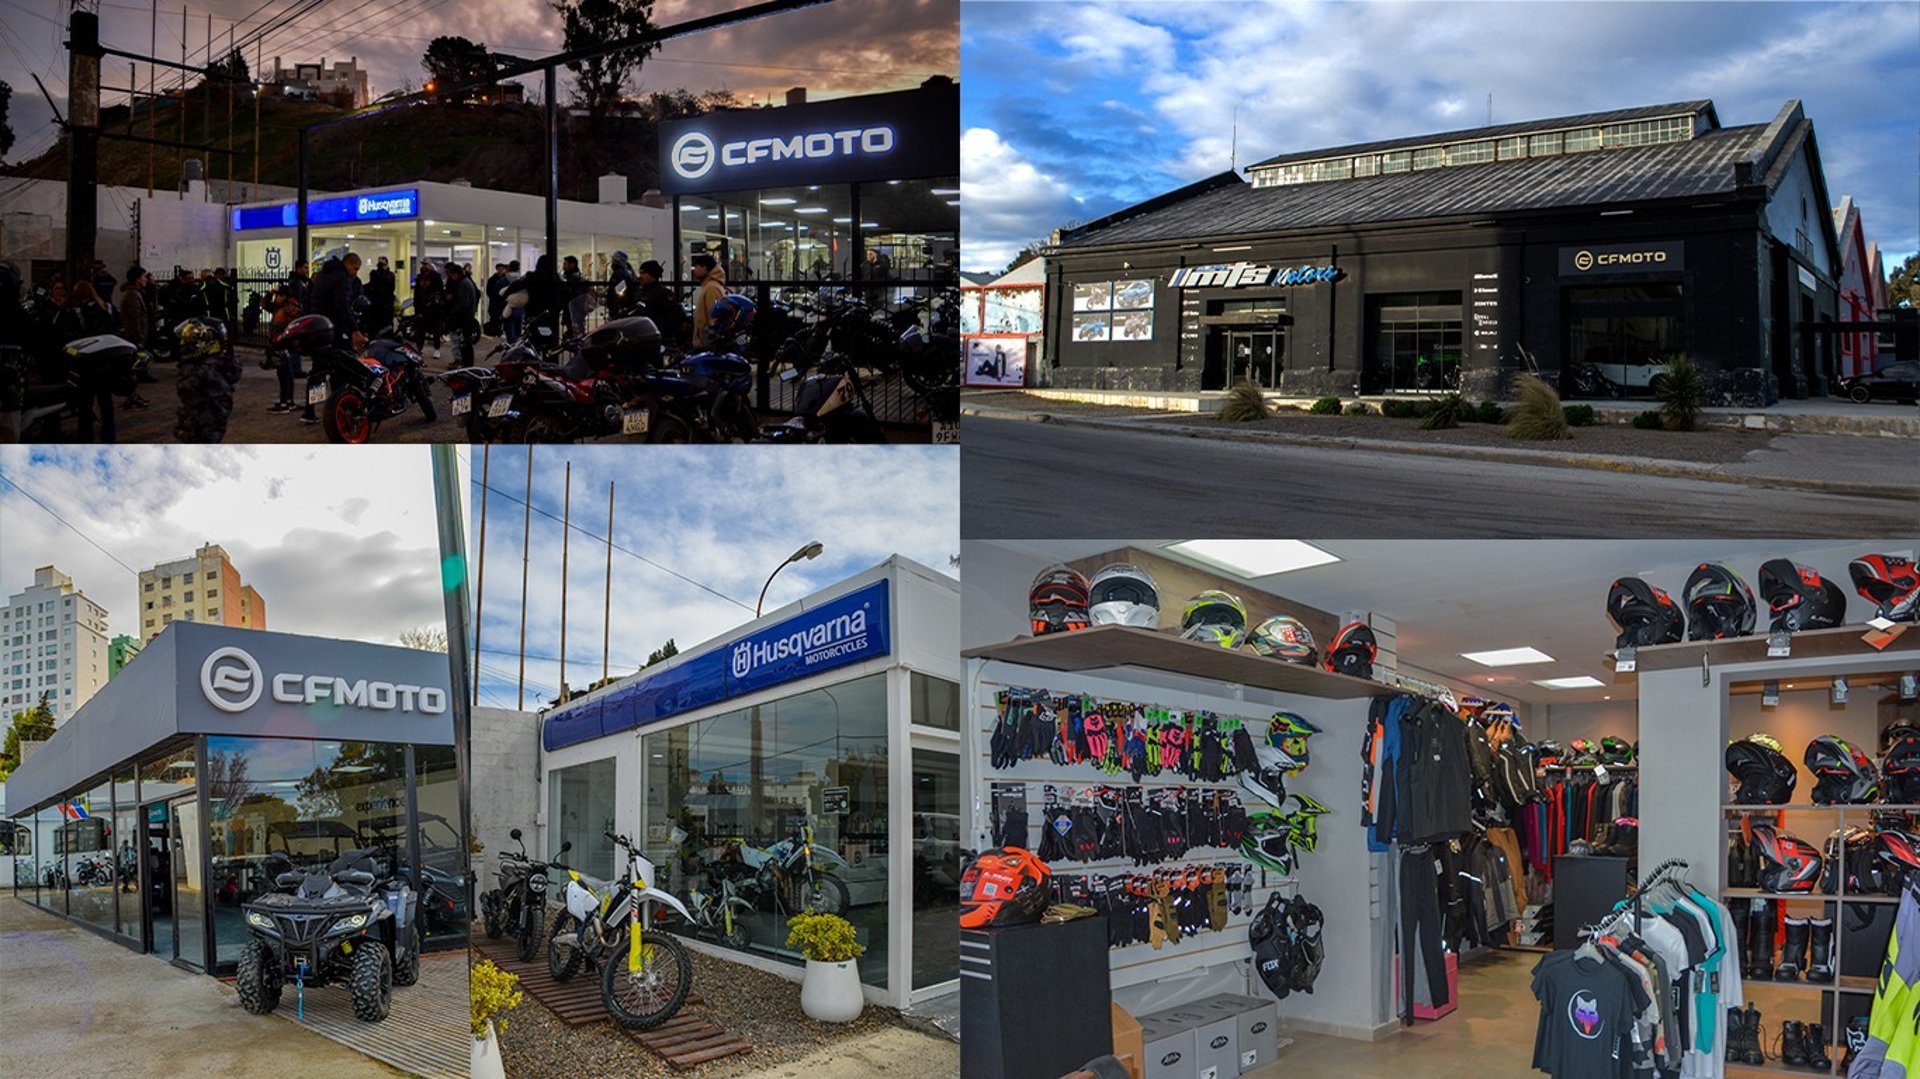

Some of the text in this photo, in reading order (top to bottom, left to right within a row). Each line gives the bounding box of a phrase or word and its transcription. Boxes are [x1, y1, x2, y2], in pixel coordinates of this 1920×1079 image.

[721, 127, 894, 166] CFMOTO
[1598, 251, 1667, 265] CFMOTO
[753, 609, 867, 668] Husqvarna
[805, 637, 868, 666] MOTORCYCLES
[272, 672, 447, 714] CFMOTO
[1262, 959, 1279, 972] FOX
